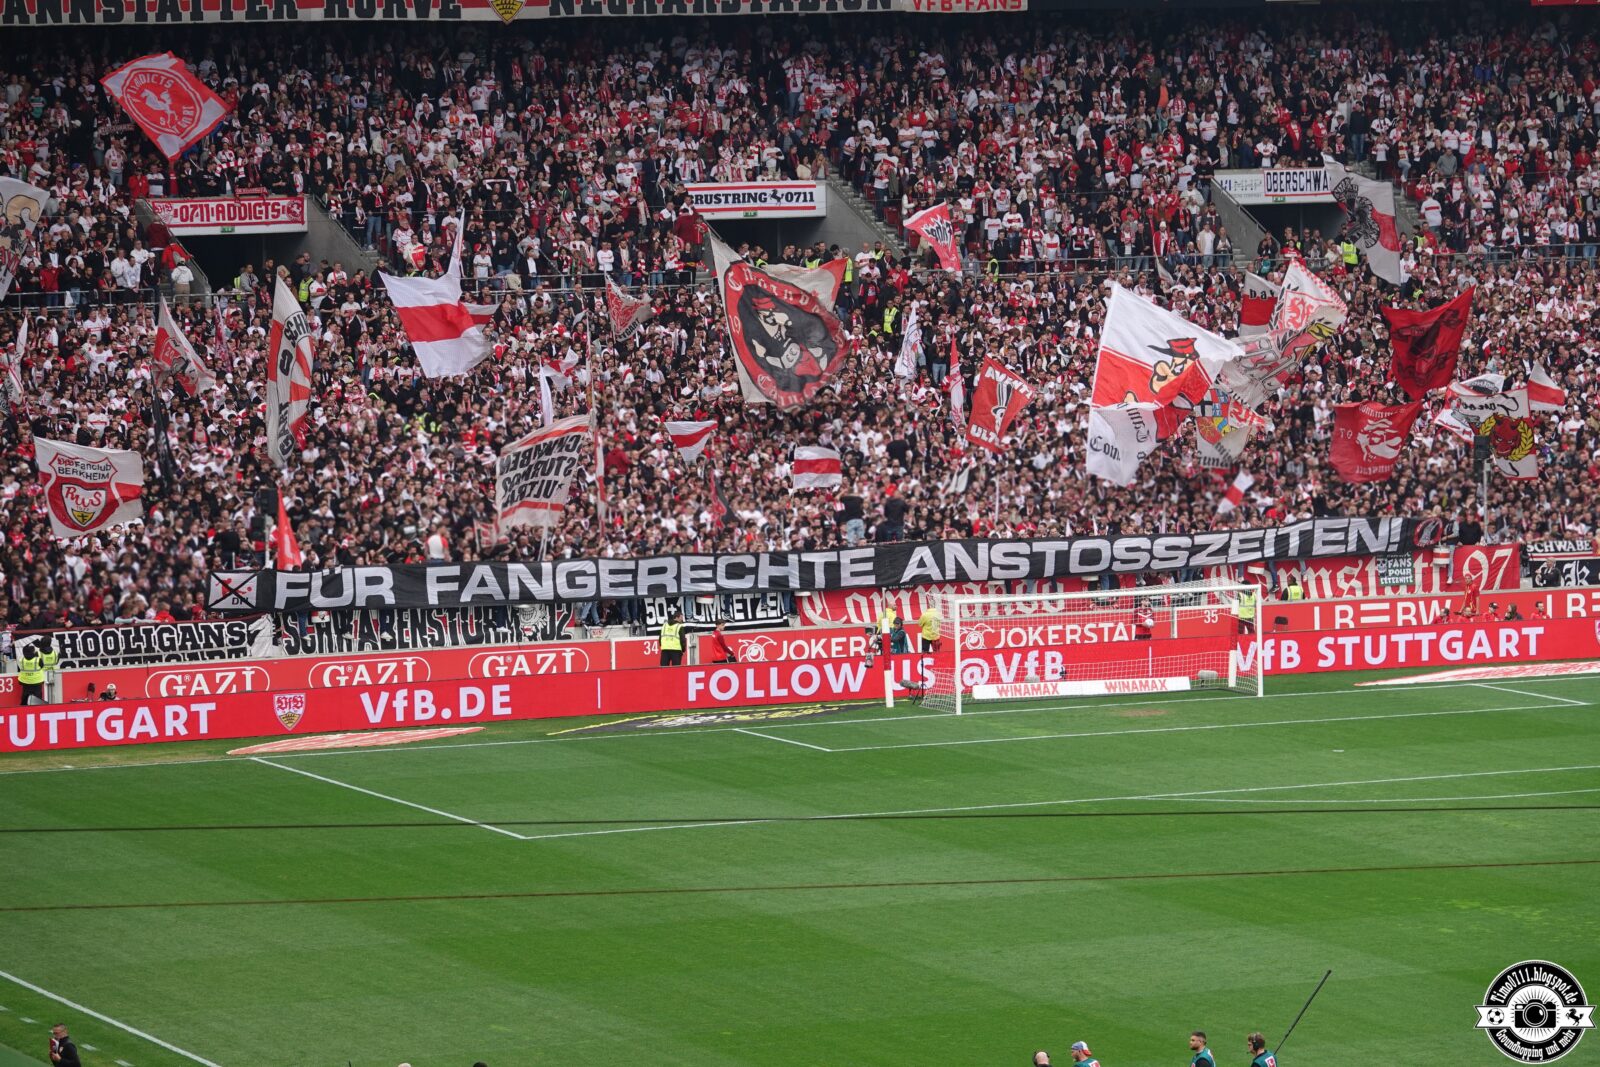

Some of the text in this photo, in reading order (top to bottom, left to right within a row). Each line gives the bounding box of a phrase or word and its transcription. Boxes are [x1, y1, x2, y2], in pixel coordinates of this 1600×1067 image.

[691, 192, 815, 205] RUSTRING 0711
[58, 467, 109, 480] BERKHEIM
[275, 517, 1400, 609] FÜR FANGERECHTE ANSTOSSZEITEN!
[1388, 558, 1412, 568] FANS
[1462, 548, 1513, 592] 97
[1388, 568, 1412, 577] POUR
[1204, 610, 1218, 624] 35
[54, 621, 248, 660] HOOLIGANS
[644, 641, 659, 655] 34
[1317, 627, 1545, 668] STUTTGART
[688, 650, 1064, 702] FOLLOW US @VfB
[996, 679, 1168, 697] WINAMAX WINAMAX
[360, 685, 513, 724] VfB.DE
